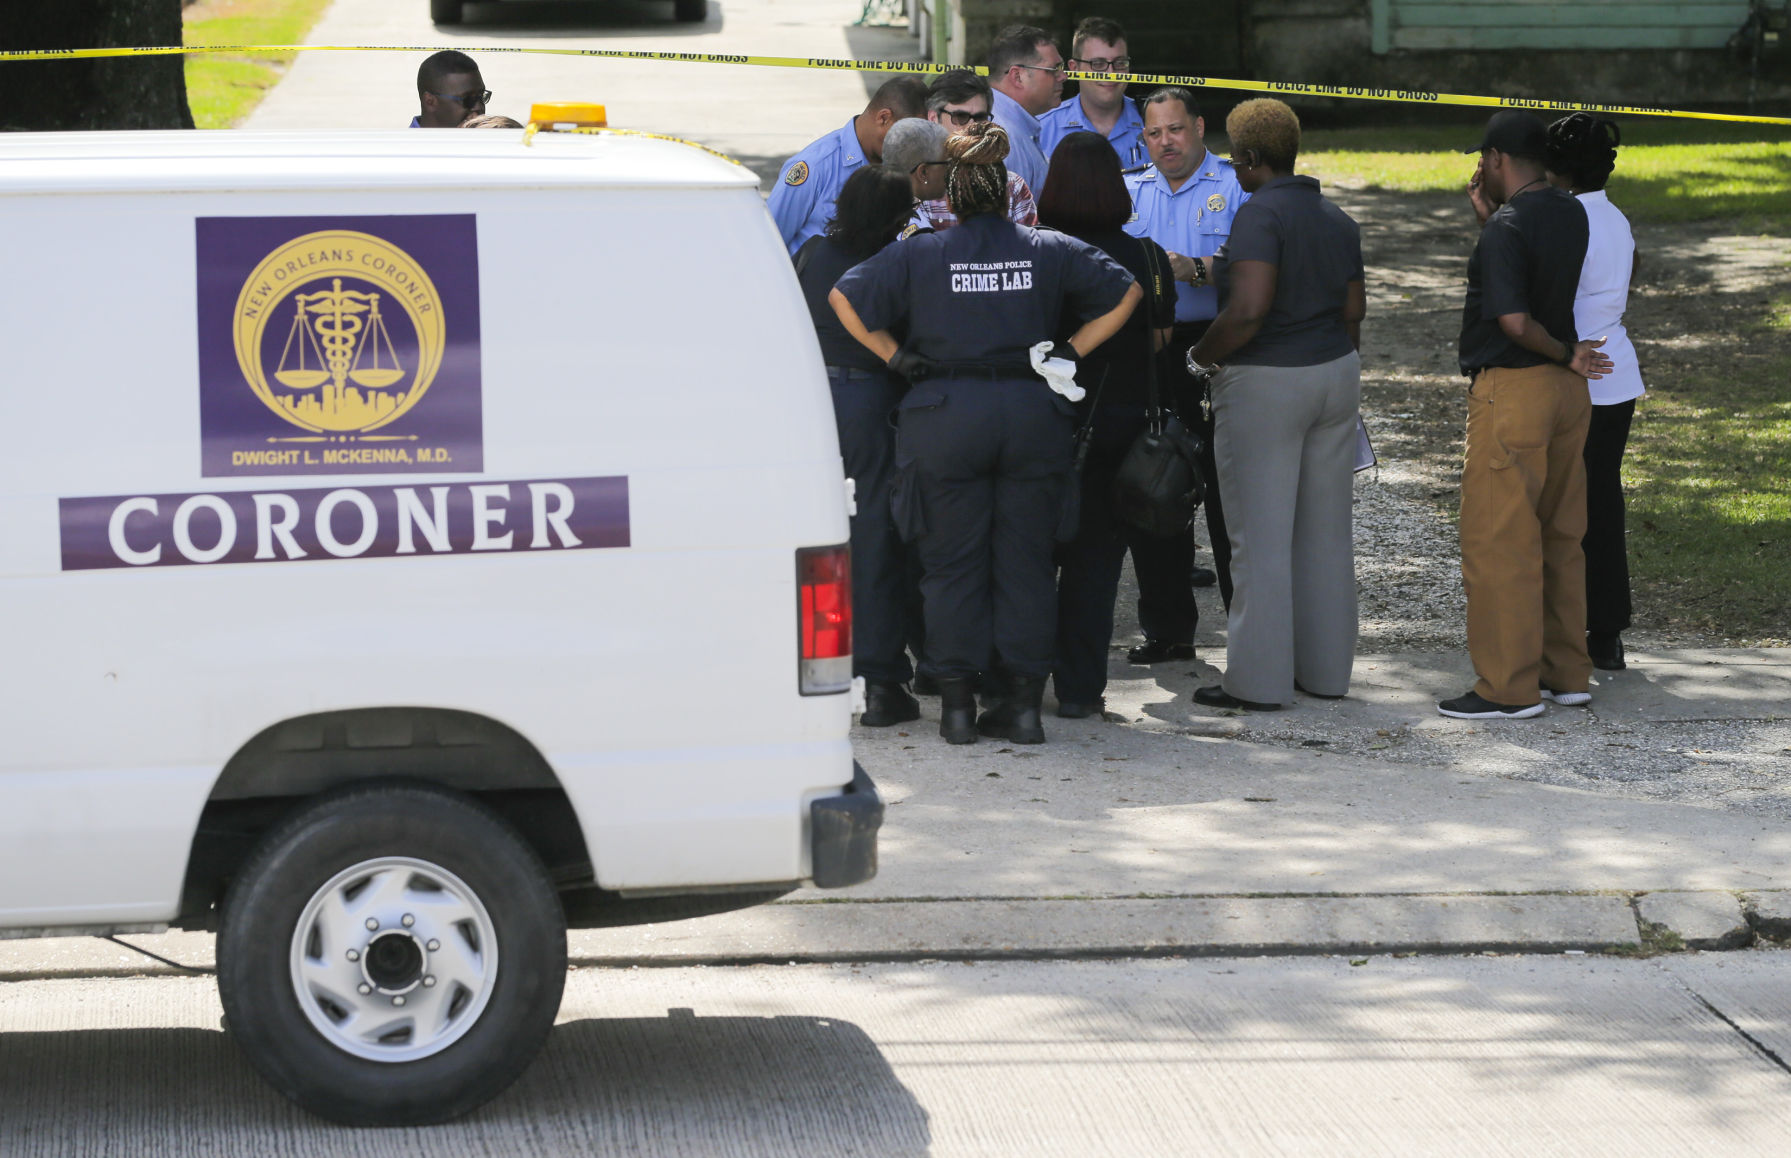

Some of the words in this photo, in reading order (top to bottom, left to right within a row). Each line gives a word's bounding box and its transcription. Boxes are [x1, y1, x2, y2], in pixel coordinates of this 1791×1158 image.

[950, 263, 968, 271] NEW
[970, 262, 1004, 271] ORLEANS
[1004, 260, 1032, 269] POLICE
[245, 281, 272, 319] NEW
[274, 250, 354, 281] ORLEANS
[361, 253, 432, 314] CORONER
[952, 273, 999, 292] CRIME
[1002, 271, 1033, 291] LAB
[232, 450, 299, 465] DWIGHT
[304, 450, 319, 464] L.
[323, 448, 413, 464] MCKENNA,
[417, 448, 452, 462] M.D.
[107, 482, 583, 566] CORONER
